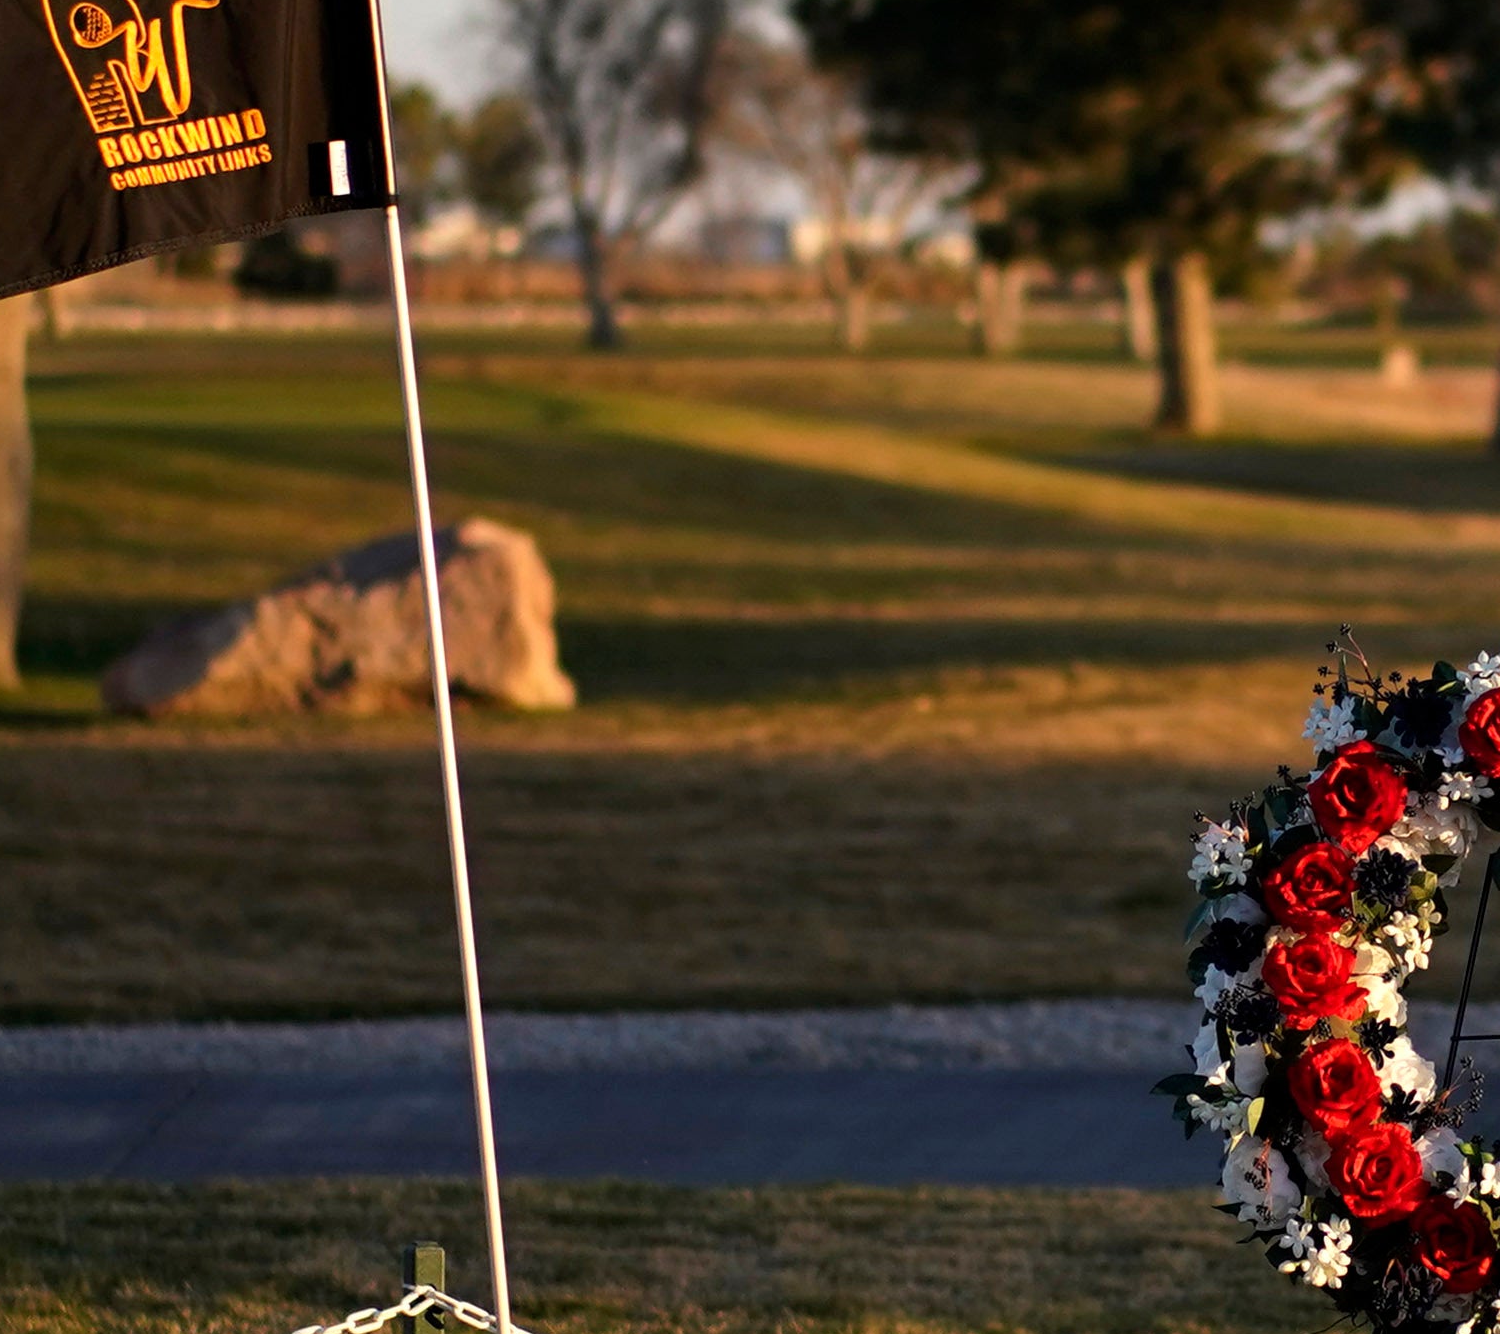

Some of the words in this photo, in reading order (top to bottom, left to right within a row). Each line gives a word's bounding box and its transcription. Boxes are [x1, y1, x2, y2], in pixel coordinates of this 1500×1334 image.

[97, 108, 267, 168] ROCKWIND
[110, 156, 217, 191] COMMUNITY
[217, 143, 273, 172] LINKS
